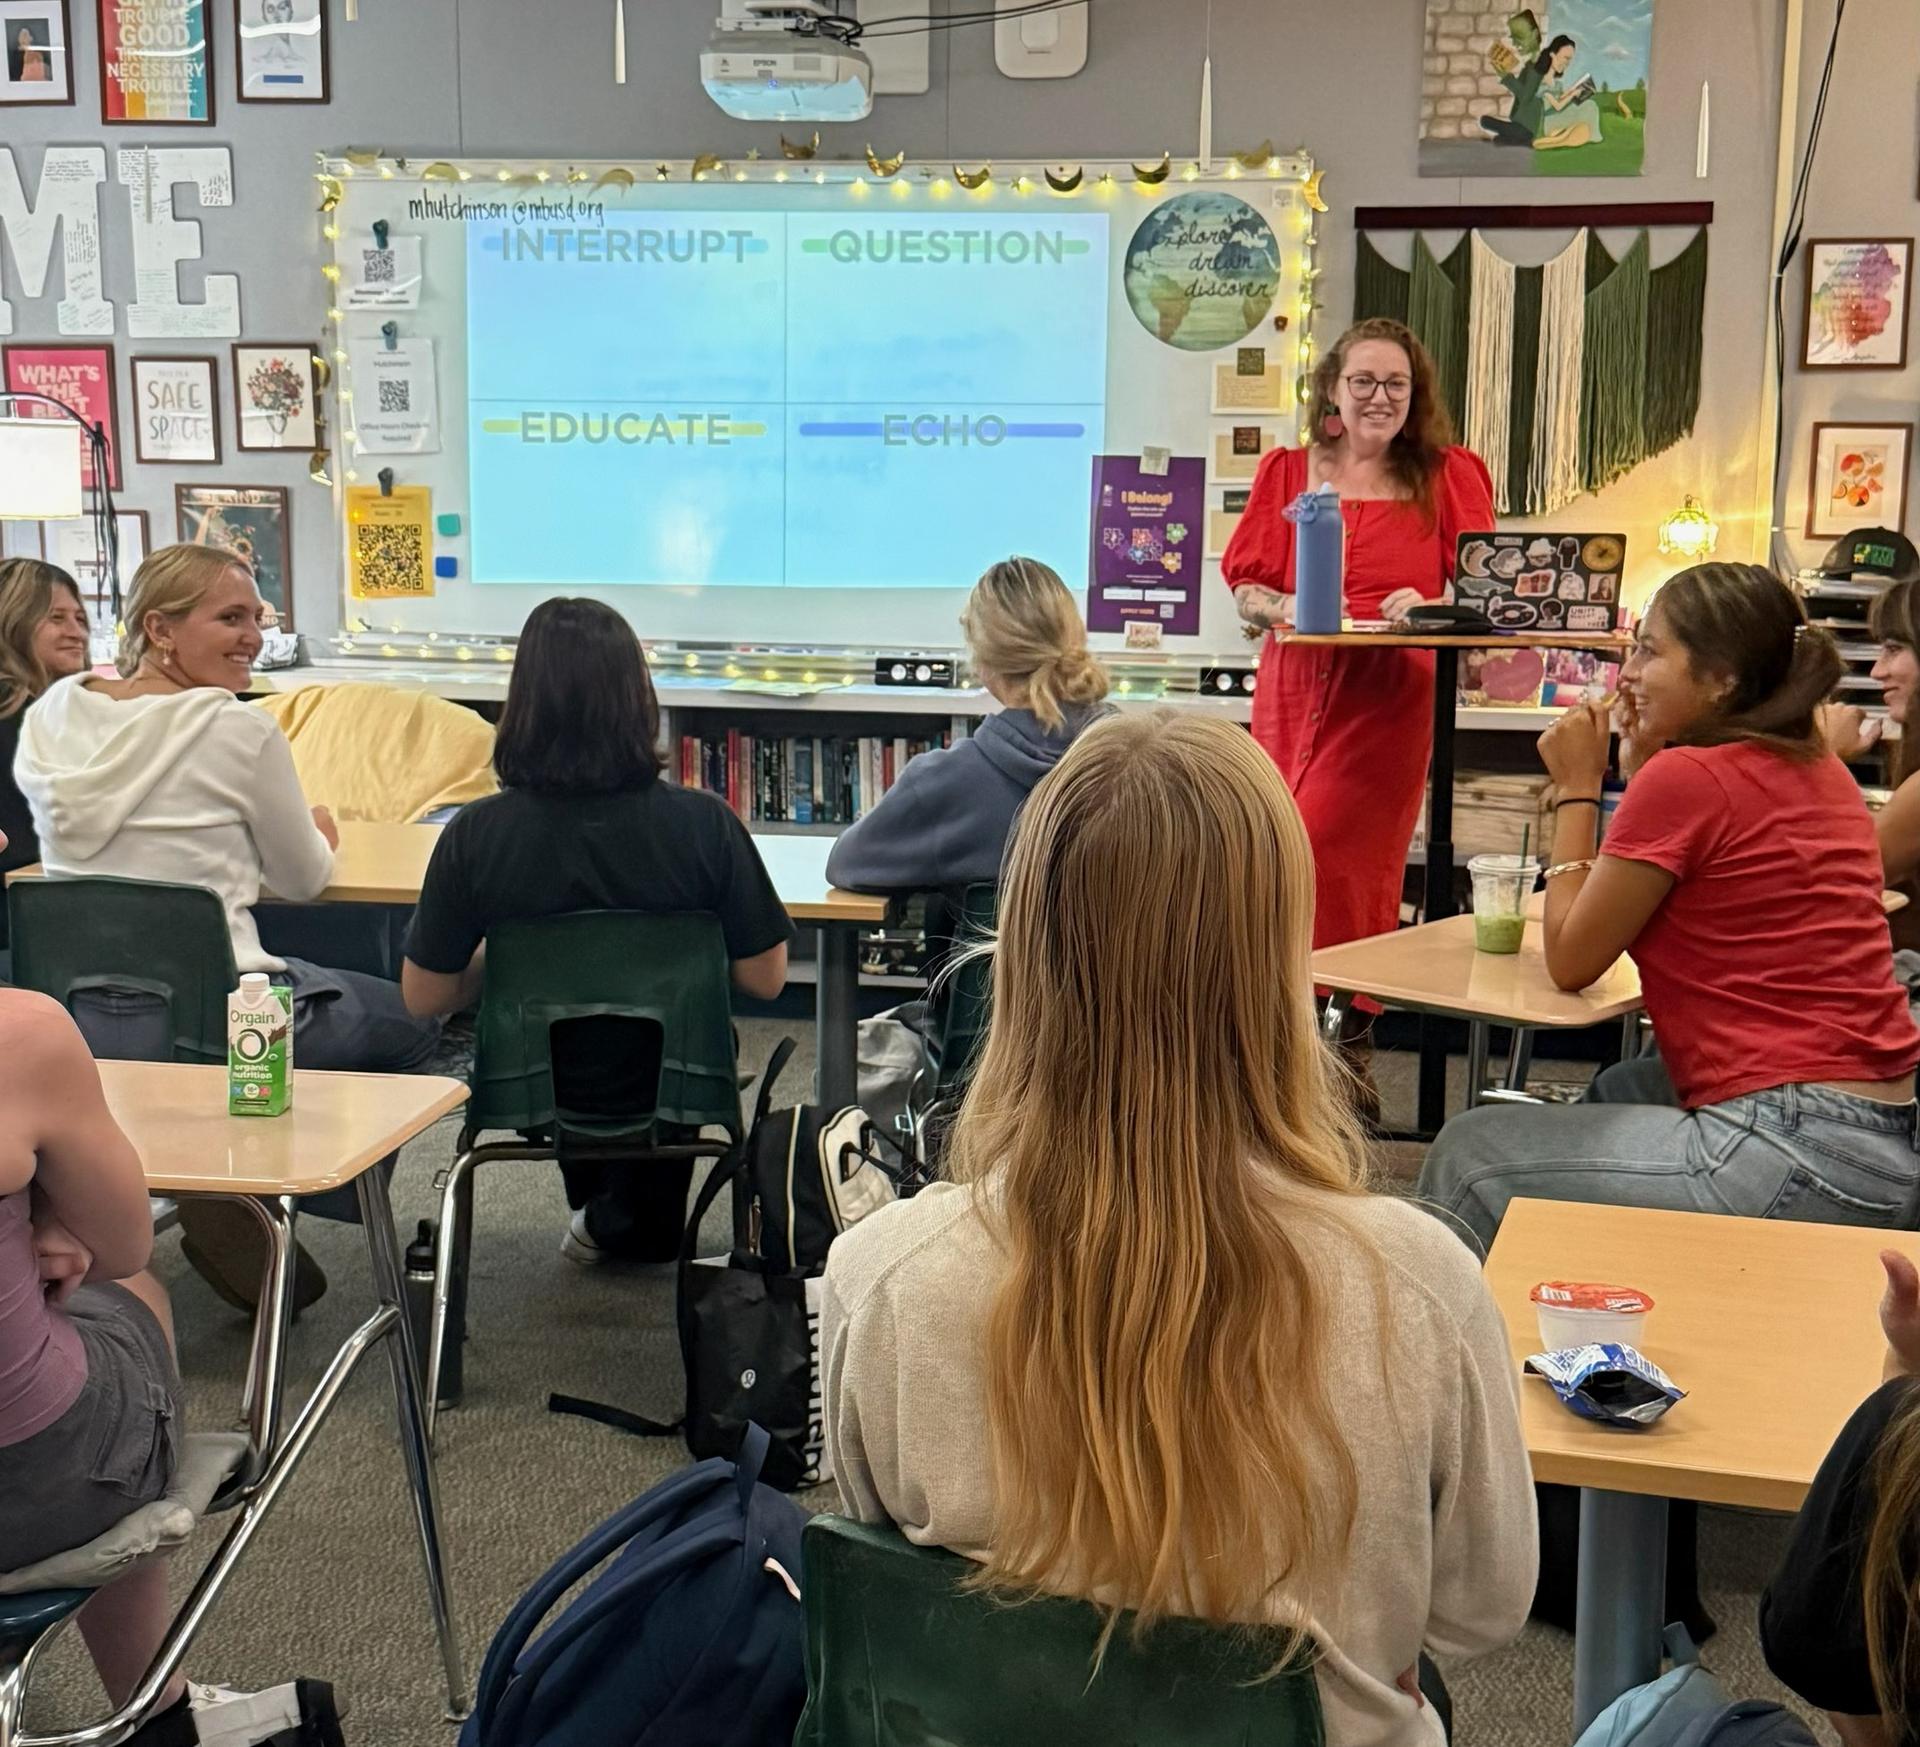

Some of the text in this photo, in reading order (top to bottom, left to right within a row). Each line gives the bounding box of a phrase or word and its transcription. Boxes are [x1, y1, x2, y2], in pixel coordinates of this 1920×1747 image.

[119, 24, 190, 46] GOOD
[106, 62, 204, 78] NECESSARY
[117, 78, 197, 93] TROUBLE.
[502, 227, 753, 263] INTERRUPT
[829, 229, 1063, 264] QUESTION
[1188, 252, 1254, 271] dream
[1184, 277, 1272, 298] discover
[18, 364, 101, 385] WHAT'S
[148, 380, 203, 410] SAFE
[32, 397, 91, 419] BET
[149, 415, 206, 441] SPACE
[521, 411, 731, 446] EDUCATE
[883, 414, 1007, 446] ECHO
[230, 1009, 276, 1026] Orgain
[232, 1071, 273, 1079] nutrition
[234, 1063, 270, 1072] organic
